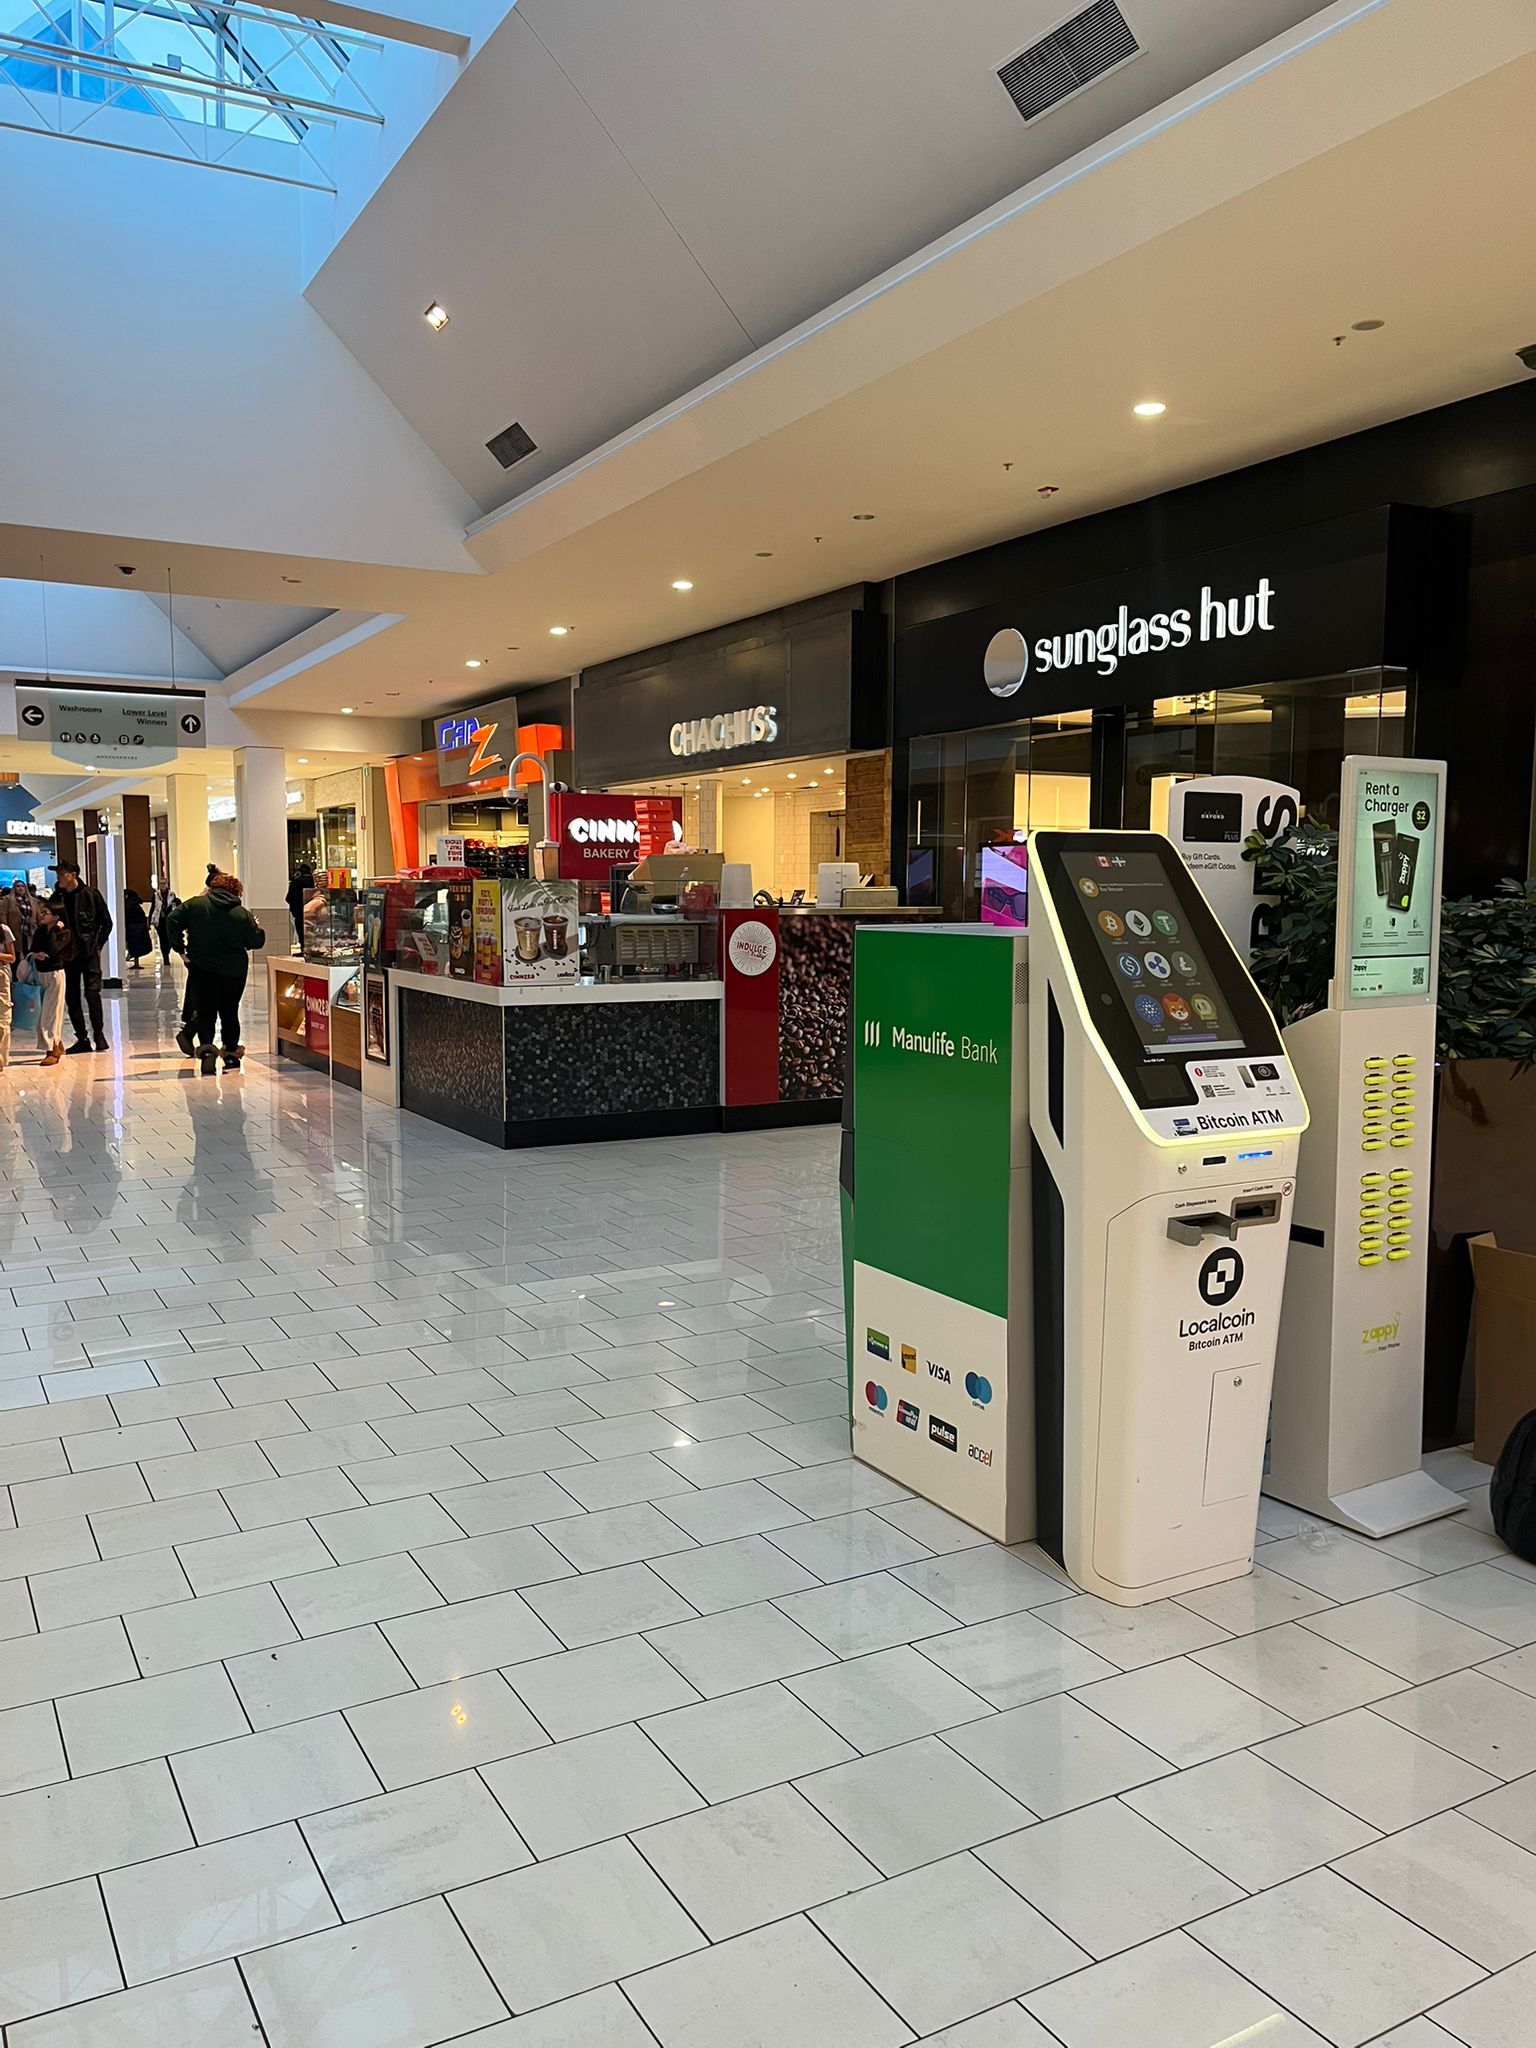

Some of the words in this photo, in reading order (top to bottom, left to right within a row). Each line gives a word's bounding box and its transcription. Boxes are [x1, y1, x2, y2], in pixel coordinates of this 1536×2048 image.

[1035, 605, 1192, 676] sunglass
[1200, 578, 1275, 642] hut
[59, 705, 102, 713] Washrooms
[122, 708, 145, 716] Lower
[148, 709, 167, 717] Level
[136, 717, 168, 726] Winners
[669, 705, 772, 756] CHACHI'S
[1365, 782, 1390, 796] Rent
[1392, 785, 1400, 796] a
[1364, 799, 1410, 817] Charger
[1416, 810, 1426, 821] $2
[1223, 832, 1239, 841] PLUS
[583, 848, 631, 859] BAKERY
[1192, 852, 1203, 860] Gift
[736, 940, 768, 954] INDULGE
[892, 1026, 955, 1057] Manulife
[961, 1036, 998, 1064] Bank
[1196, 1112, 1248, 1130] Bitcoin
[1251, 1108, 1284, 1126] ATM
[1179, 1308, 1255, 1338] Localcoin
[1189, 1336, 1221, 1351] Bitcoin
[1222, 1332, 1244, 1345] ATM
[1362, 1321, 1399, 1344] zappy
[926, 1360, 951, 1384] VISA
[930, 1423, 955, 1443] pulse
[968, 1444, 993, 1467] accel
